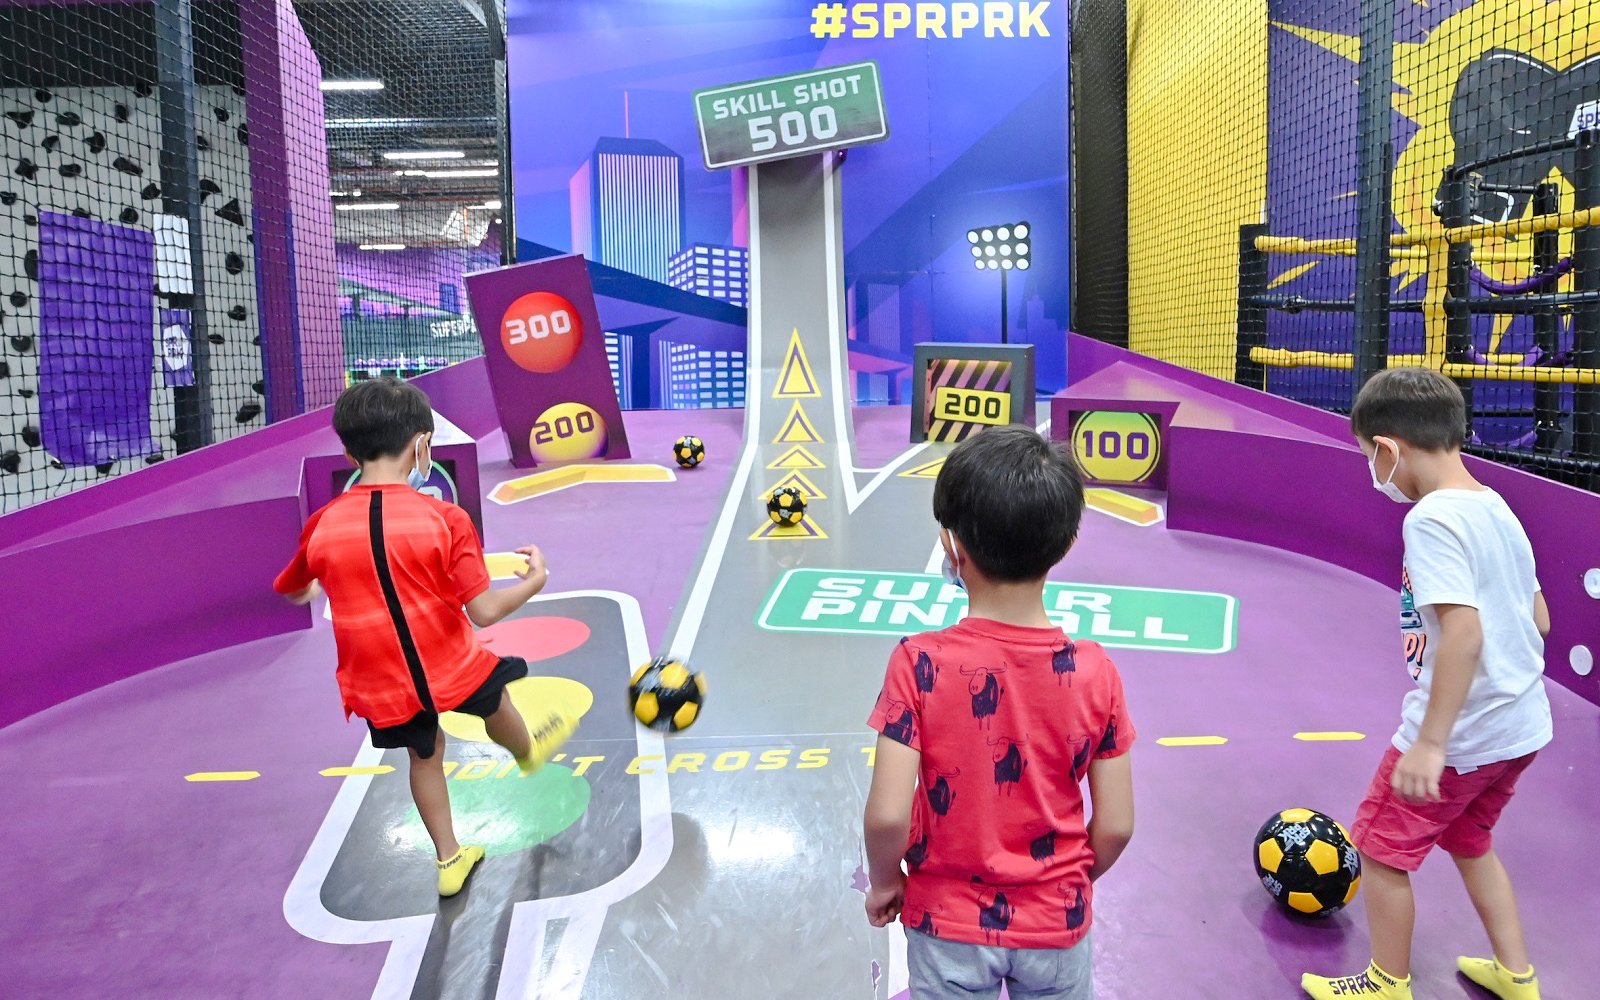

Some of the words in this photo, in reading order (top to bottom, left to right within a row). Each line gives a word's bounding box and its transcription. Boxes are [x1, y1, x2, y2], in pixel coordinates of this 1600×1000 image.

[810, 1, 1051, 39] #SPRPRK
[712, 89, 786, 121] SKILL
[793, 74, 862, 104] SHOT
[748, 105, 839, 152] 500
[505, 309, 572, 345] 300
[944, 393, 1001, 419] 200
[532, 411, 595, 445] 200
[1082, 430, 1149, 460] 100
[811, 577, 1112, 615] SUPR
[801, 597, 1189, 641] PINALL
[624, 748, 831, 775] CROSS
